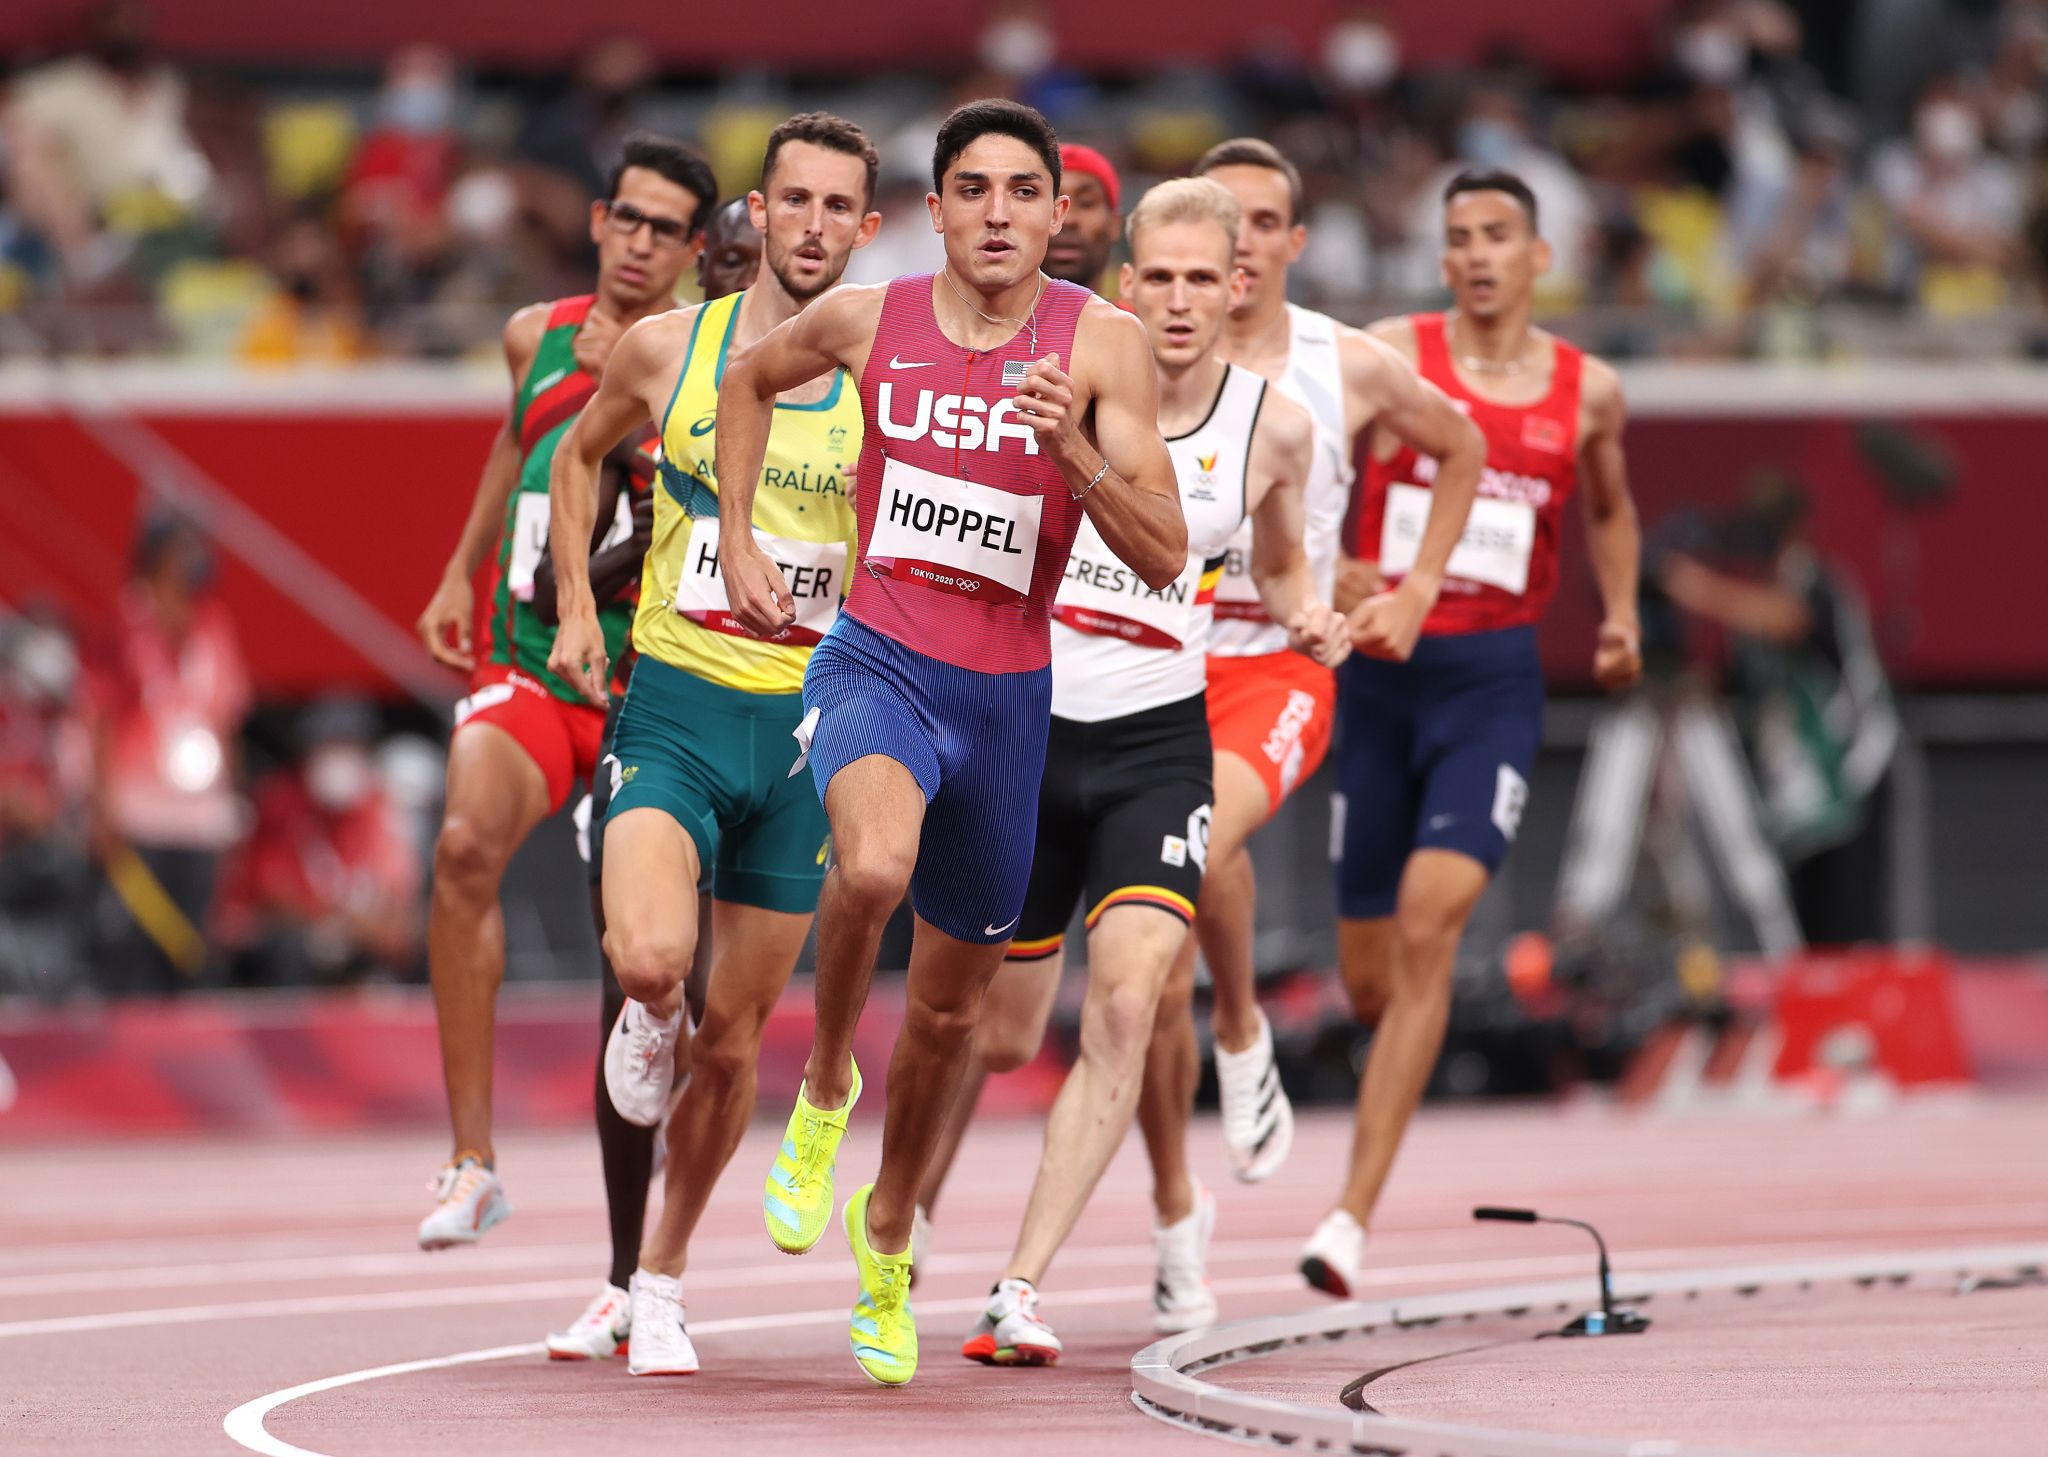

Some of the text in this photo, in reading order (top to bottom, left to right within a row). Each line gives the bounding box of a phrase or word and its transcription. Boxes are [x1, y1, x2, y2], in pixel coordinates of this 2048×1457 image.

[878, 382, 1039, 456] USA
[696, 458, 839, 496] ARALIA
[889, 488, 1022, 554] HOPPEL
[696, 542, 833, 599] HTER
[910, 566, 954, 585] TOKYO 2020
